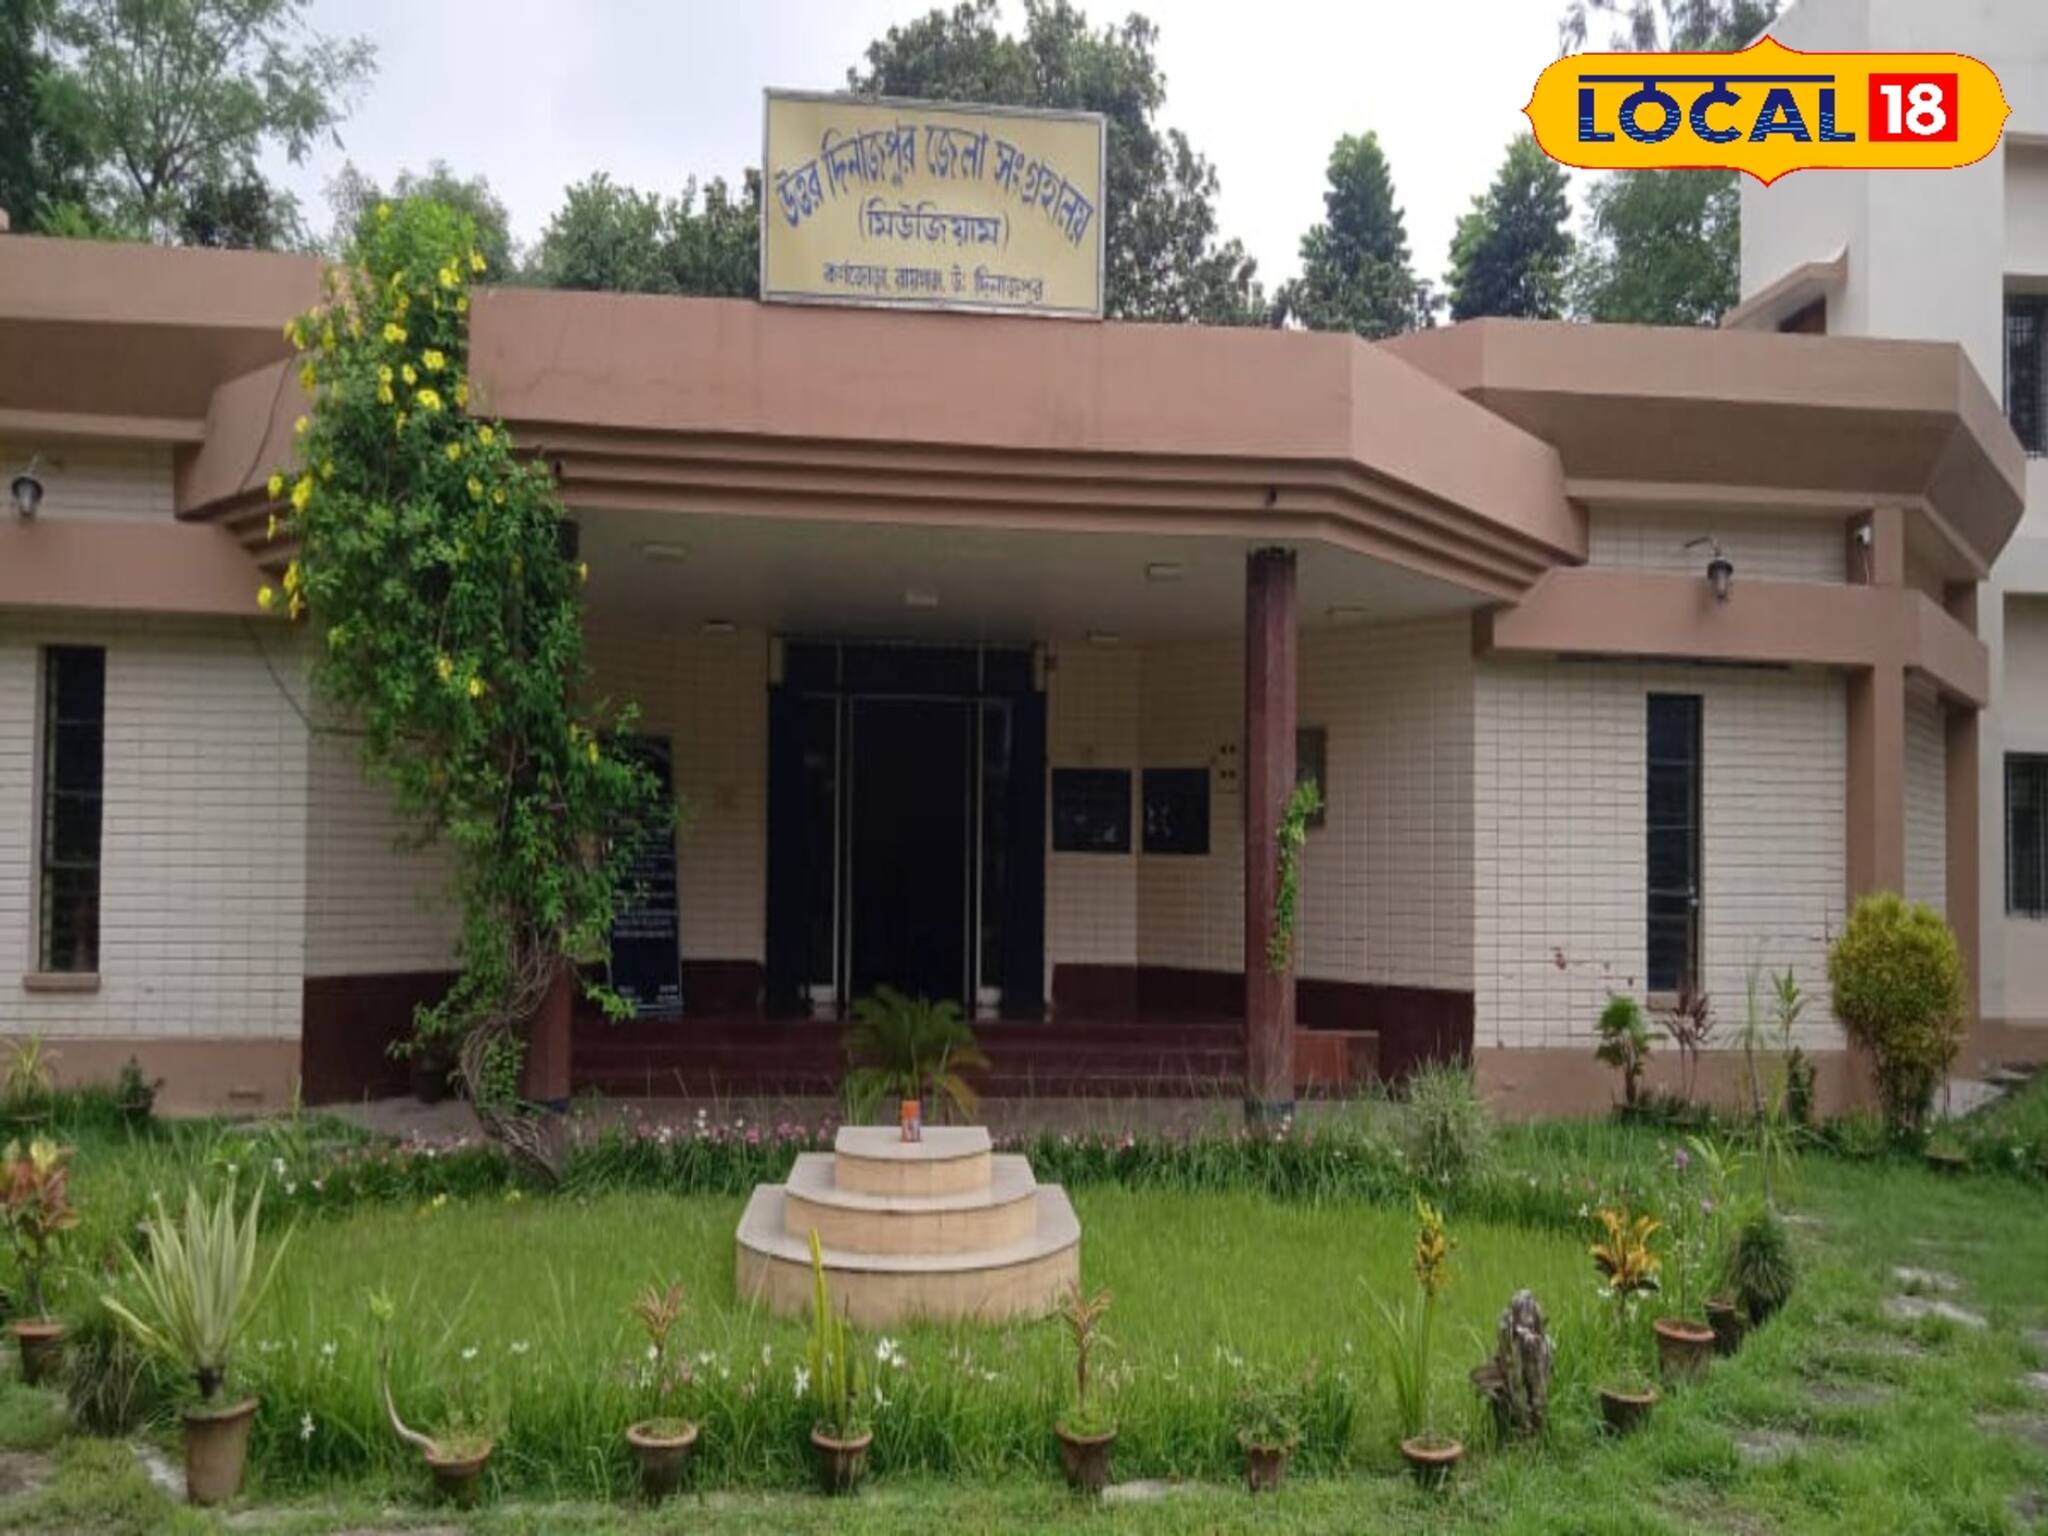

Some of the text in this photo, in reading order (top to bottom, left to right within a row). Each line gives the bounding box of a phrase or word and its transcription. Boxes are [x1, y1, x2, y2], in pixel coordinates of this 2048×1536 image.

[775, 159, 824, 228] উত্তর
[820, 118, 918, 199] দিনাজপুর
[925, 125, 988, 180] জেলা
